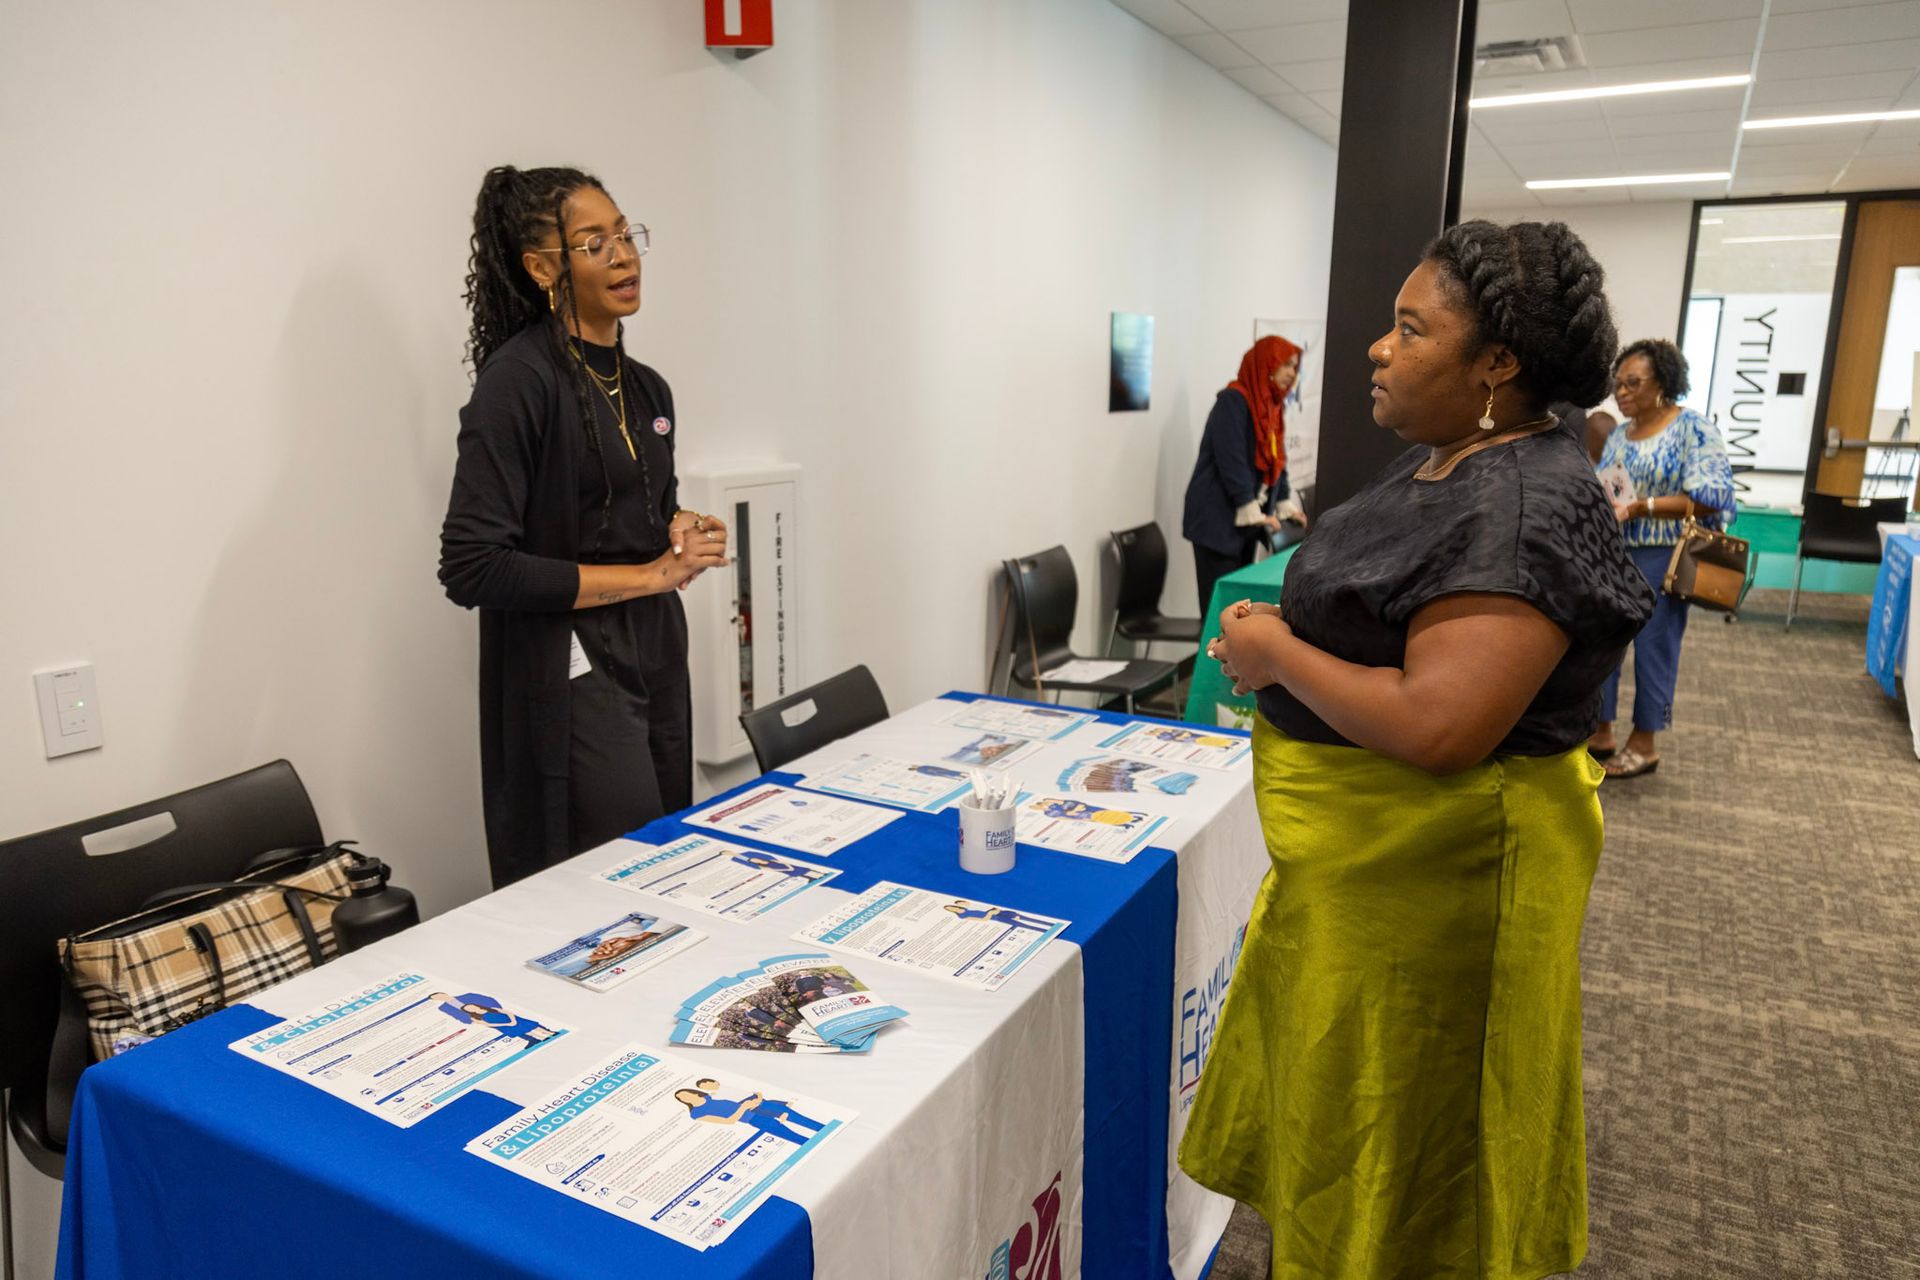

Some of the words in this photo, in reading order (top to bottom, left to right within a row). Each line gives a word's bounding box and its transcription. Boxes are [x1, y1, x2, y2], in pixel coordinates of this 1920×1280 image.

[246, 1014, 315, 1046] Heart
[258, 1042, 279, 1051] &
[283, 974, 425, 1039] Cholesterol
[481, 1112, 539, 1150] Family
[537, 1086, 584, 1115] Heart
[581, 1050, 638, 1086] Disease
[500, 1143, 521, 1157] &
[514, 1055, 658, 1144] Lipoprotein(a)
